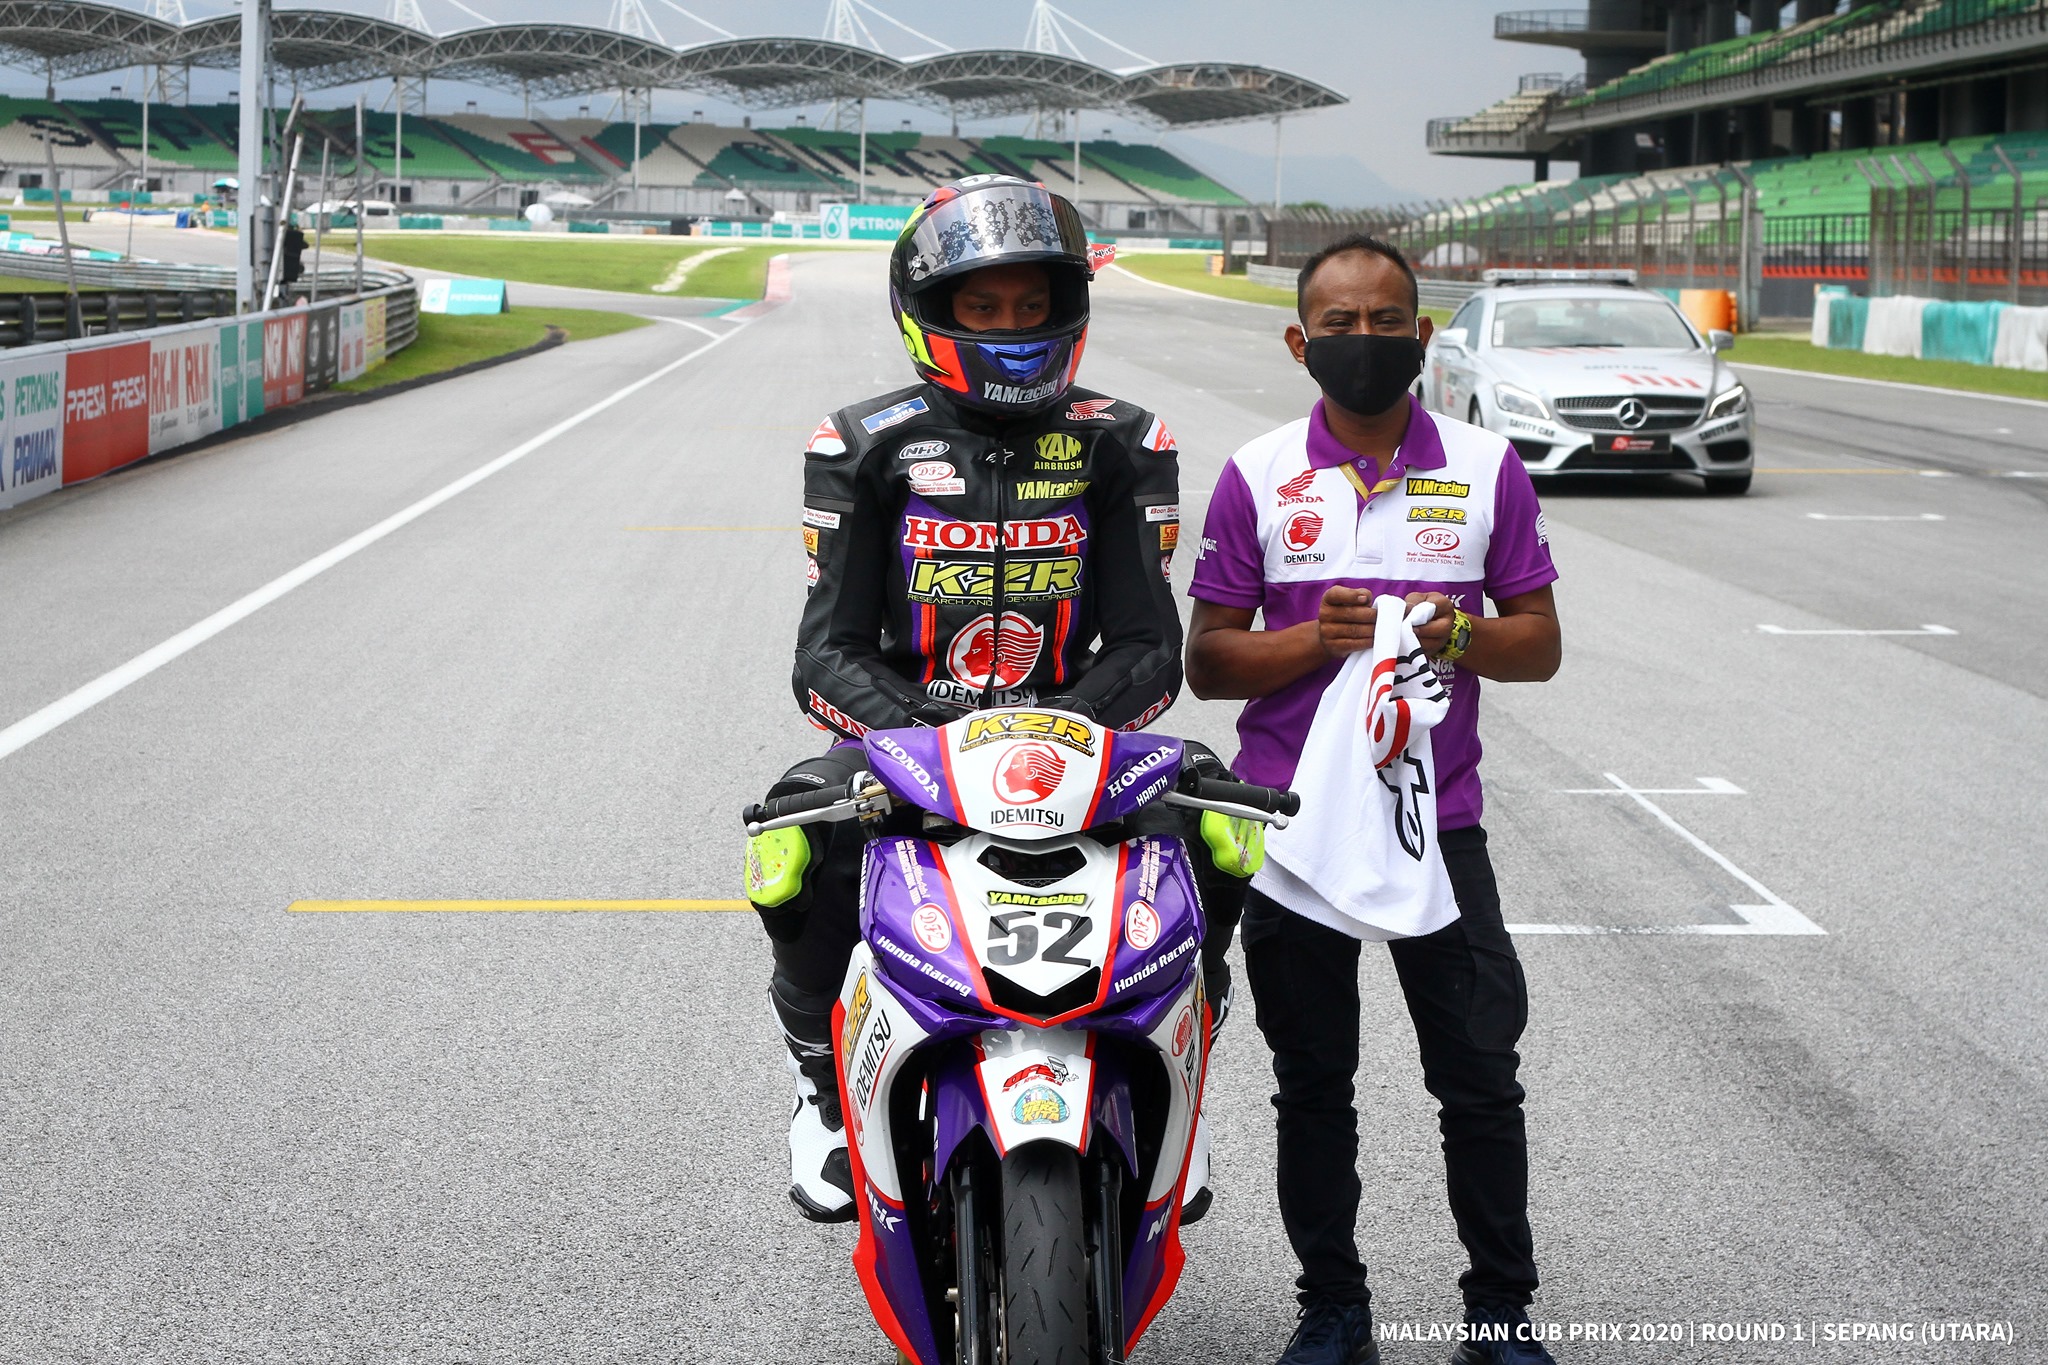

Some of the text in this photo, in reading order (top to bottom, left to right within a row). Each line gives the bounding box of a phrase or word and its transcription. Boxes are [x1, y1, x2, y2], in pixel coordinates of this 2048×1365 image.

[15, 371, 59, 417] PETRONAS
[112, 374, 147, 412] PRESA
[984, 379, 1058, 403] YAMracing
[66, 384, 107, 424] PRESA
[878, 407, 916, 427] ASHUKA
[1067, 412, 1116, 421] HONDA
[1509, 418, 1555, 438] SAFETY CAR
[1699, 425, 1724, 440] SAFETY
[12, 428, 57, 488] PRIMAX
[1036, 433, 1082, 461] YAM
[1034, 460, 1083, 471] AIRBRUSH
[1016, 479, 1091, 501] YAMracing
[1407, 479, 1470, 498] YAMracing
[1277, 495, 1325, 508] HONDA
[815, 511, 836, 521] Honda
[905, 515, 1086, 549] HONDA
[1422, 533, 1453, 546] DFZ
[1283, 553, 1326, 564] IDEMITSU
[908, 589, 1082, 607] RESEARCH AND DEVELOPMENT
[960, 734, 1006, 752] RESEARCH
[1033, 734, 1095, 757] DEVELOPMENT
[876, 736, 940, 802] HONDA
[1108, 745, 1177, 799] HONDA
[1136, 775, 1168, 807] HARITH
[991, 808, 1065, 827] IDEMITSU
[988, 891, 1085, 906] YAMracing
[919, 911, 946, 944] DFZ
[1131, 909, 1151, 943] DFZ
[987, 911, 1093, 968] 52
[876, 935, 973, 998] Honda Racing
[1114, 935, 1196, 994] Honda Racing
[856, 1008, 892, 1112] IDEMITSU
